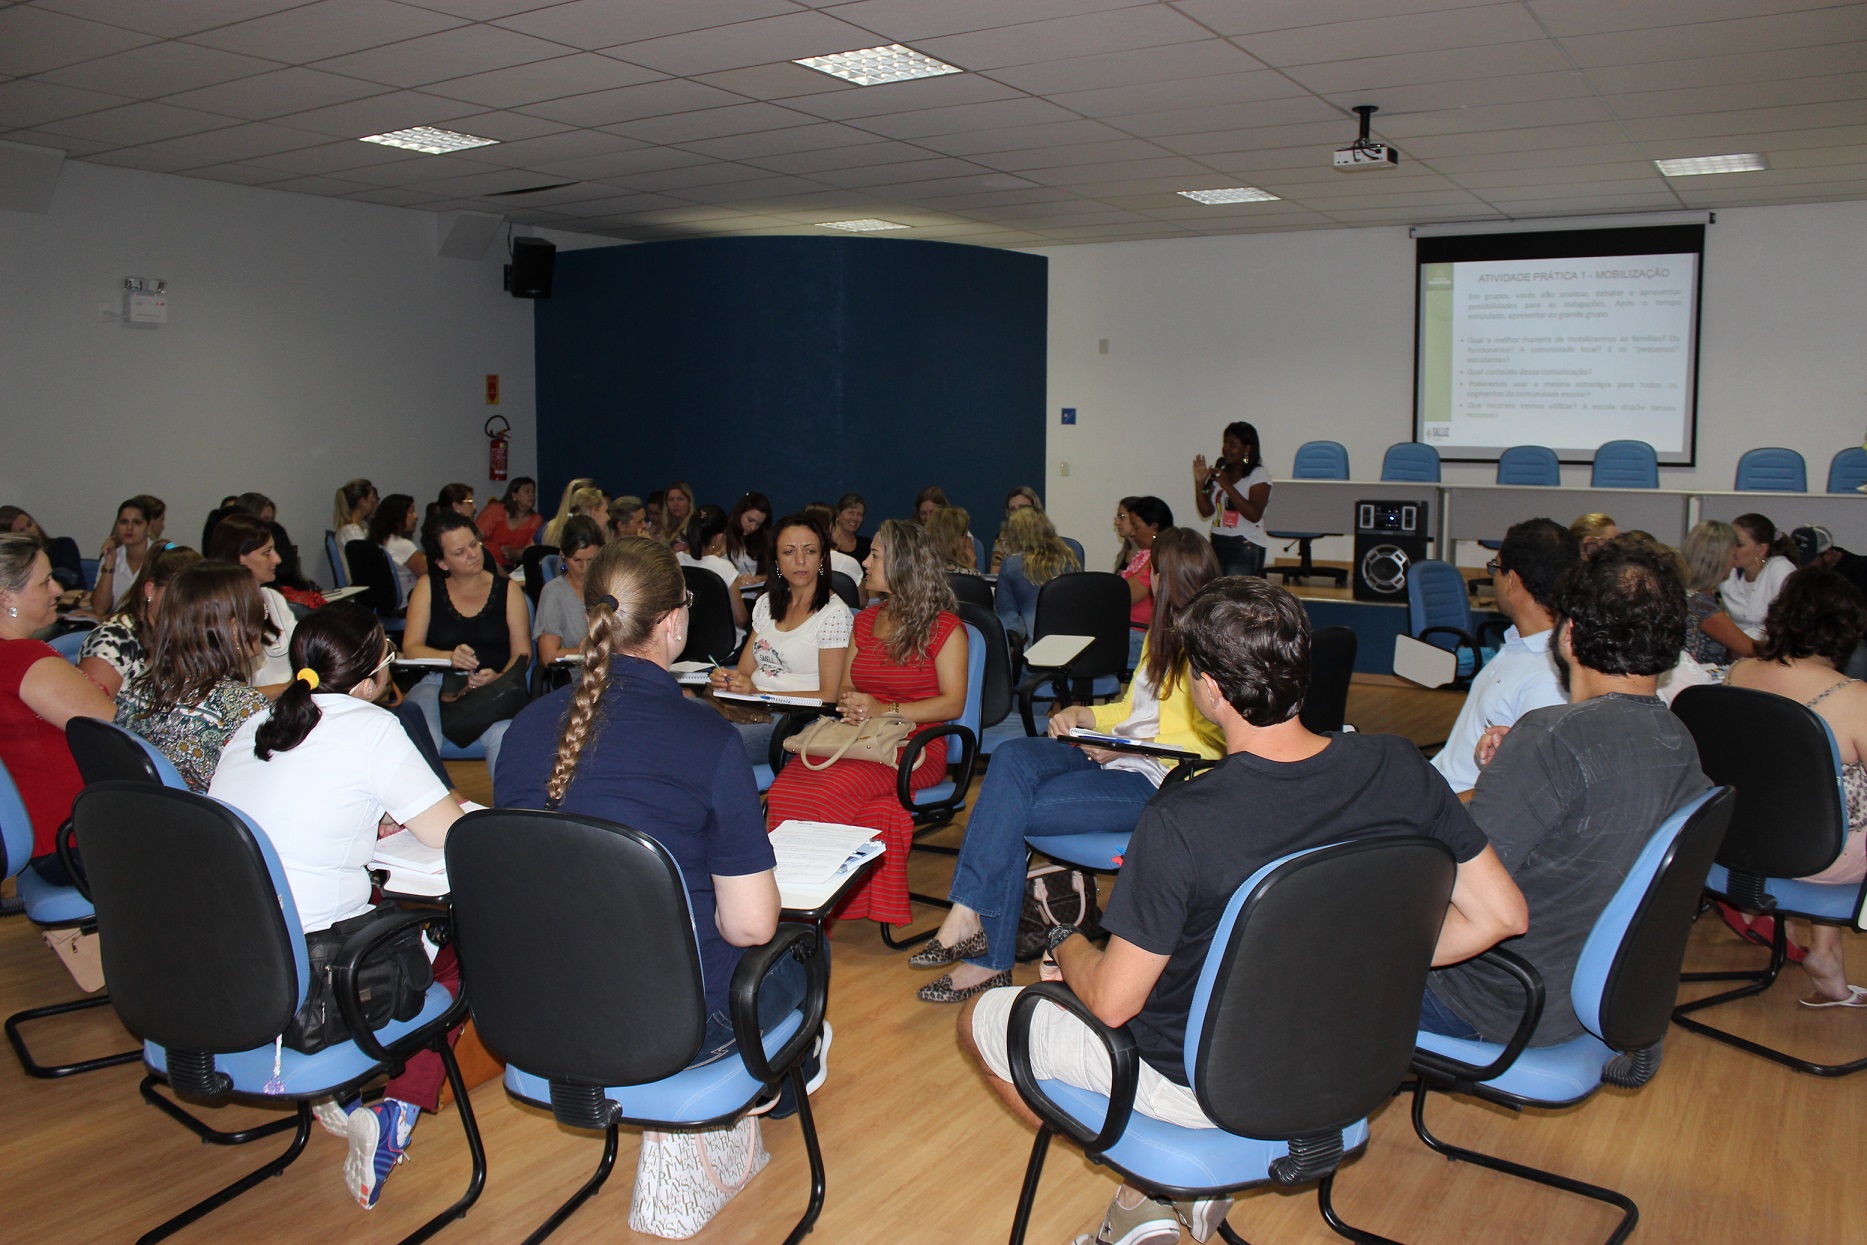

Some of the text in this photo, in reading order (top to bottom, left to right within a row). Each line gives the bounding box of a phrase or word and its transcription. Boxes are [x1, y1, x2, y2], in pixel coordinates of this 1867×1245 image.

[1478, 273, 1531, 282] ATIVIDADE
[1534, 271, 1578, 281] PRÁTICA
[1596, 267, 1670, 279] MOBILIZAÇÃO
[760, 654, 774, 664] SMELL
